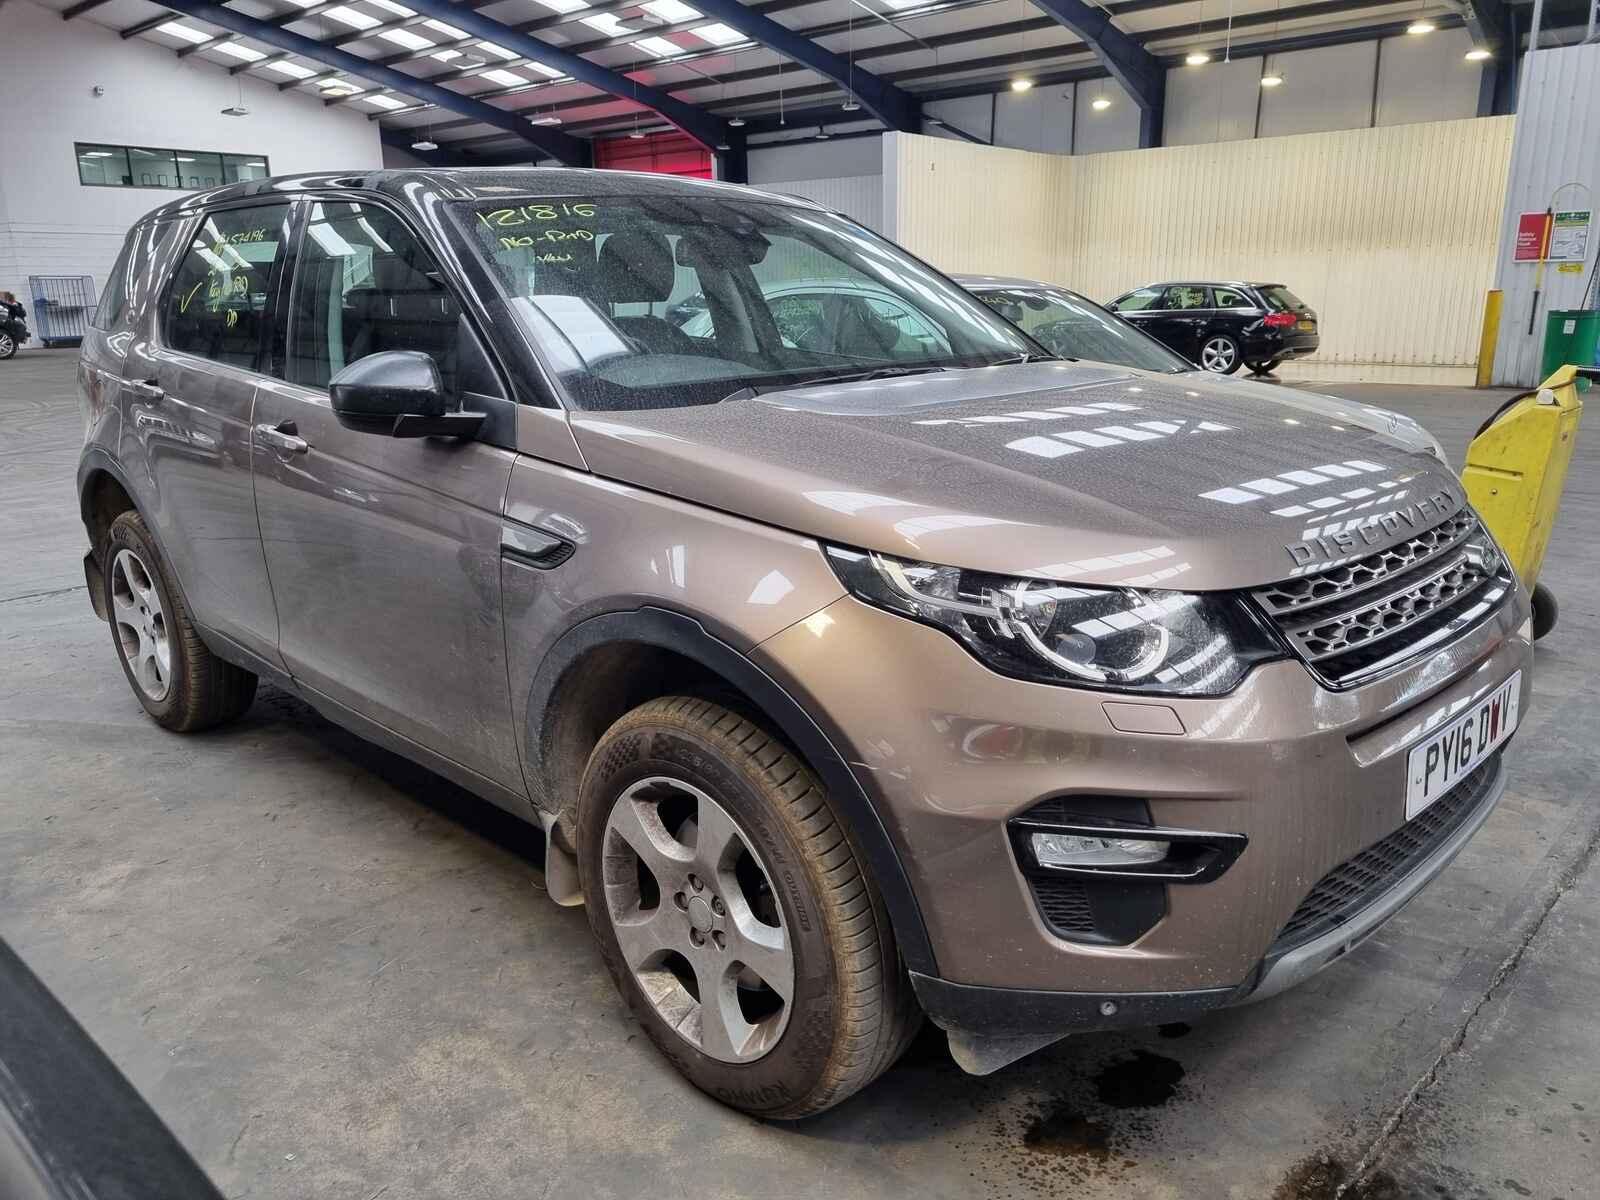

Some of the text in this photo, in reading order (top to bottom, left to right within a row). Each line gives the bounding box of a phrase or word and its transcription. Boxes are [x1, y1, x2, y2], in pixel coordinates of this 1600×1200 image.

[1285, 489, 1455, 567] DISCOVERY
[1424, 684, 1512, 797] PY16 DWV
